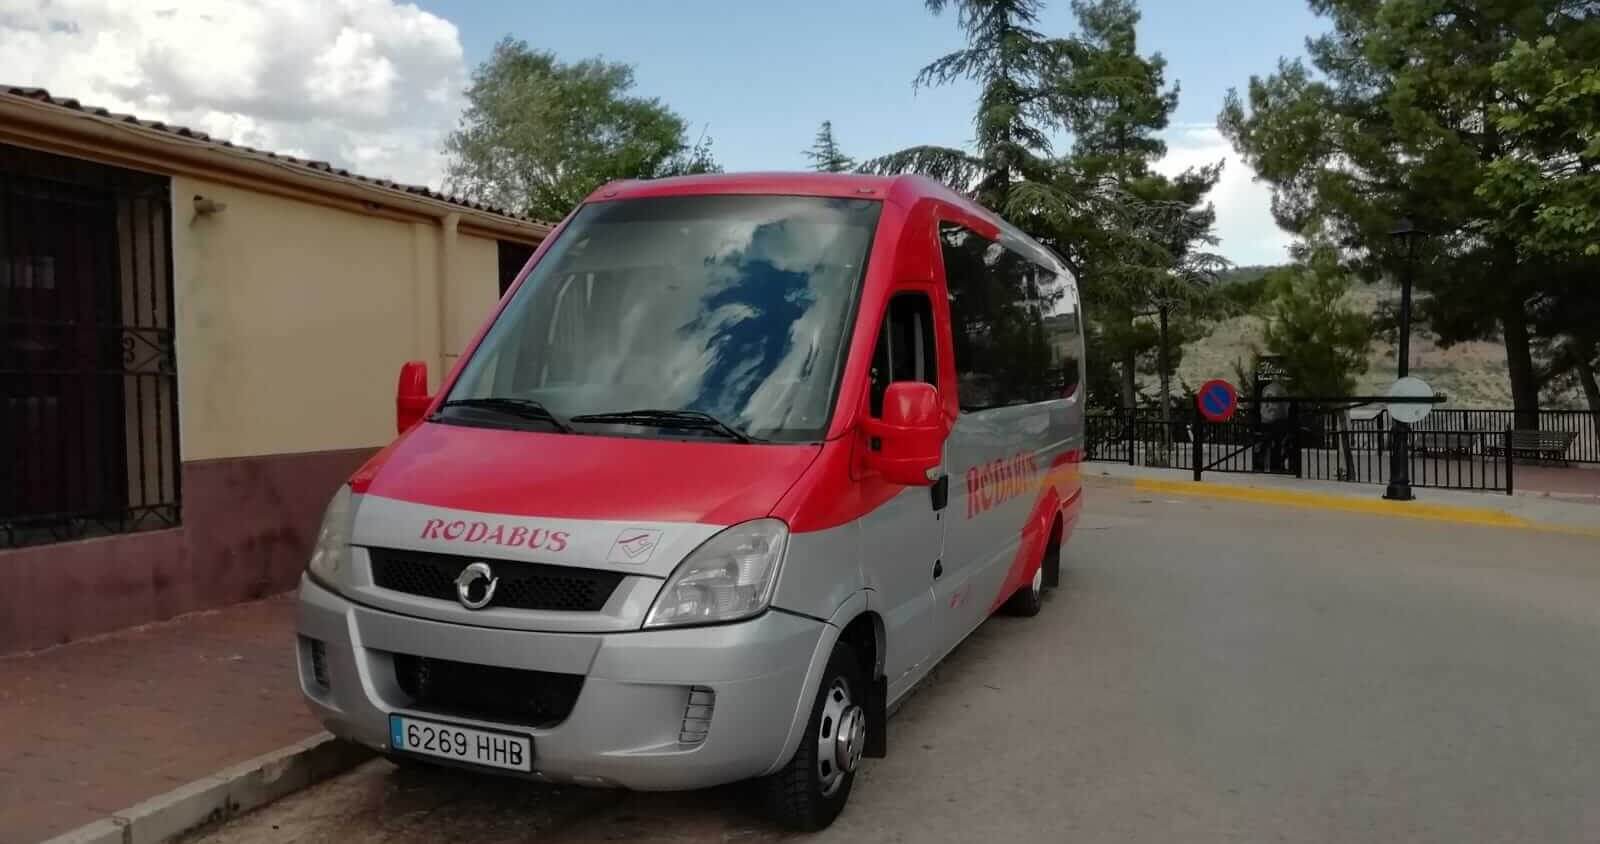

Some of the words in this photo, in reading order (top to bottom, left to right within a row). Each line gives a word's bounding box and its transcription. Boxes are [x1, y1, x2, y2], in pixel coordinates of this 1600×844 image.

[966, 451, 1039, 519] RODABUS
[421, 518, 570, 552] RODABUS
[407, 723, 467, 757] 6269
[477, 734, 522, 765] HHB
